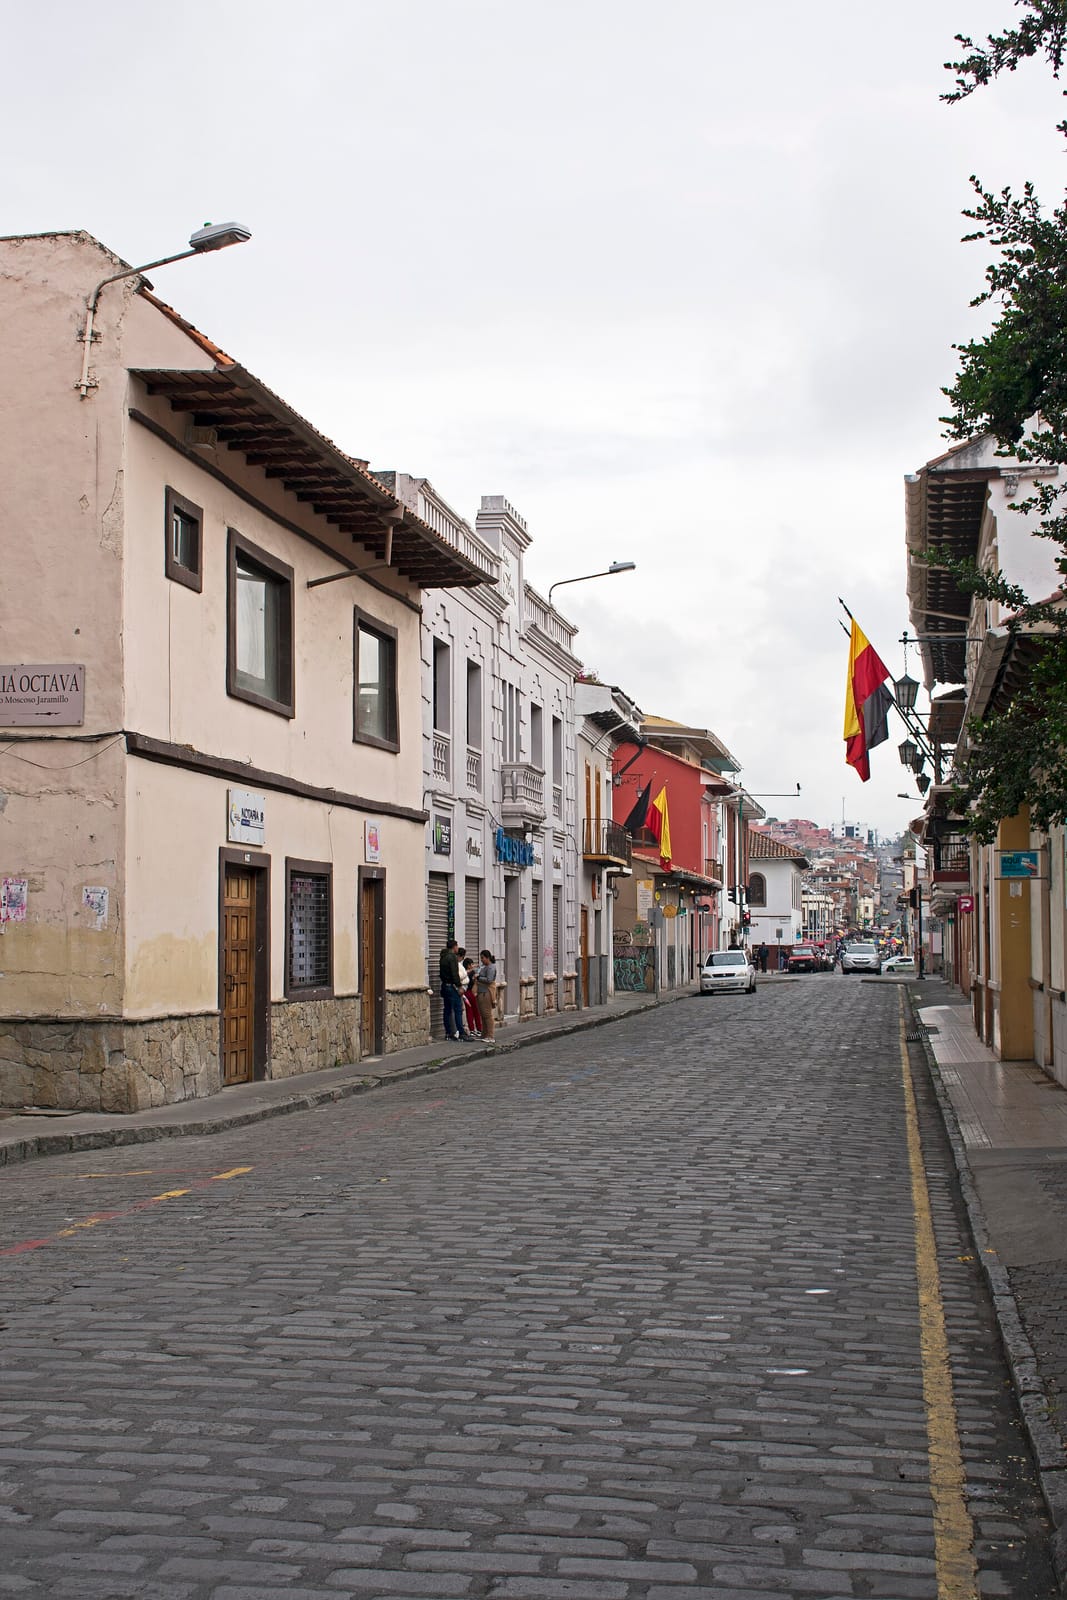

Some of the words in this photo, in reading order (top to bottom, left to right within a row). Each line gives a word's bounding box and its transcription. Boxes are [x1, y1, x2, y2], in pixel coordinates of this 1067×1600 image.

[0, 674, 16, 692] IA
[19, 674, 80, 692] OCTAVA
[5, 696, 35, 704] Moscoso
[35, 695, 69, 705] Jaramillo
